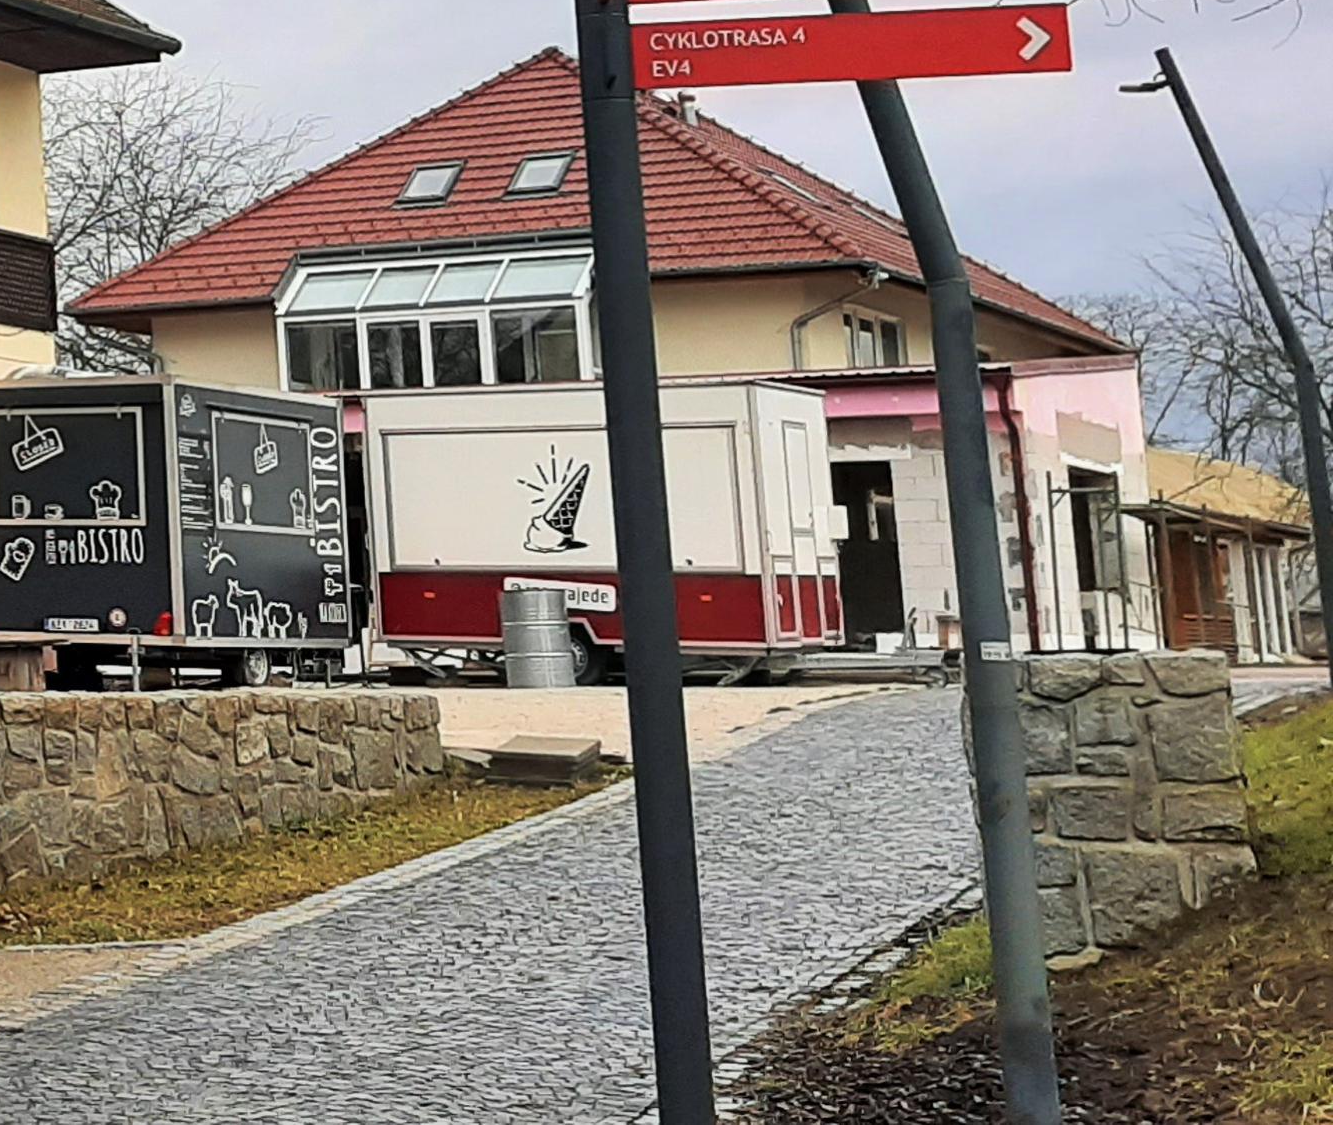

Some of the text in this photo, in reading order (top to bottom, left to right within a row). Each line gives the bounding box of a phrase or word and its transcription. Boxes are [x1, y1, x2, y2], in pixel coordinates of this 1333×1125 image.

[649, 26, 807, 52] CYKLOTRASA 4
[651, 58, 692, 78] EV4
[309, 425, 345, 557] BISTRO
[77, 527, 145, 565] BISTRO
